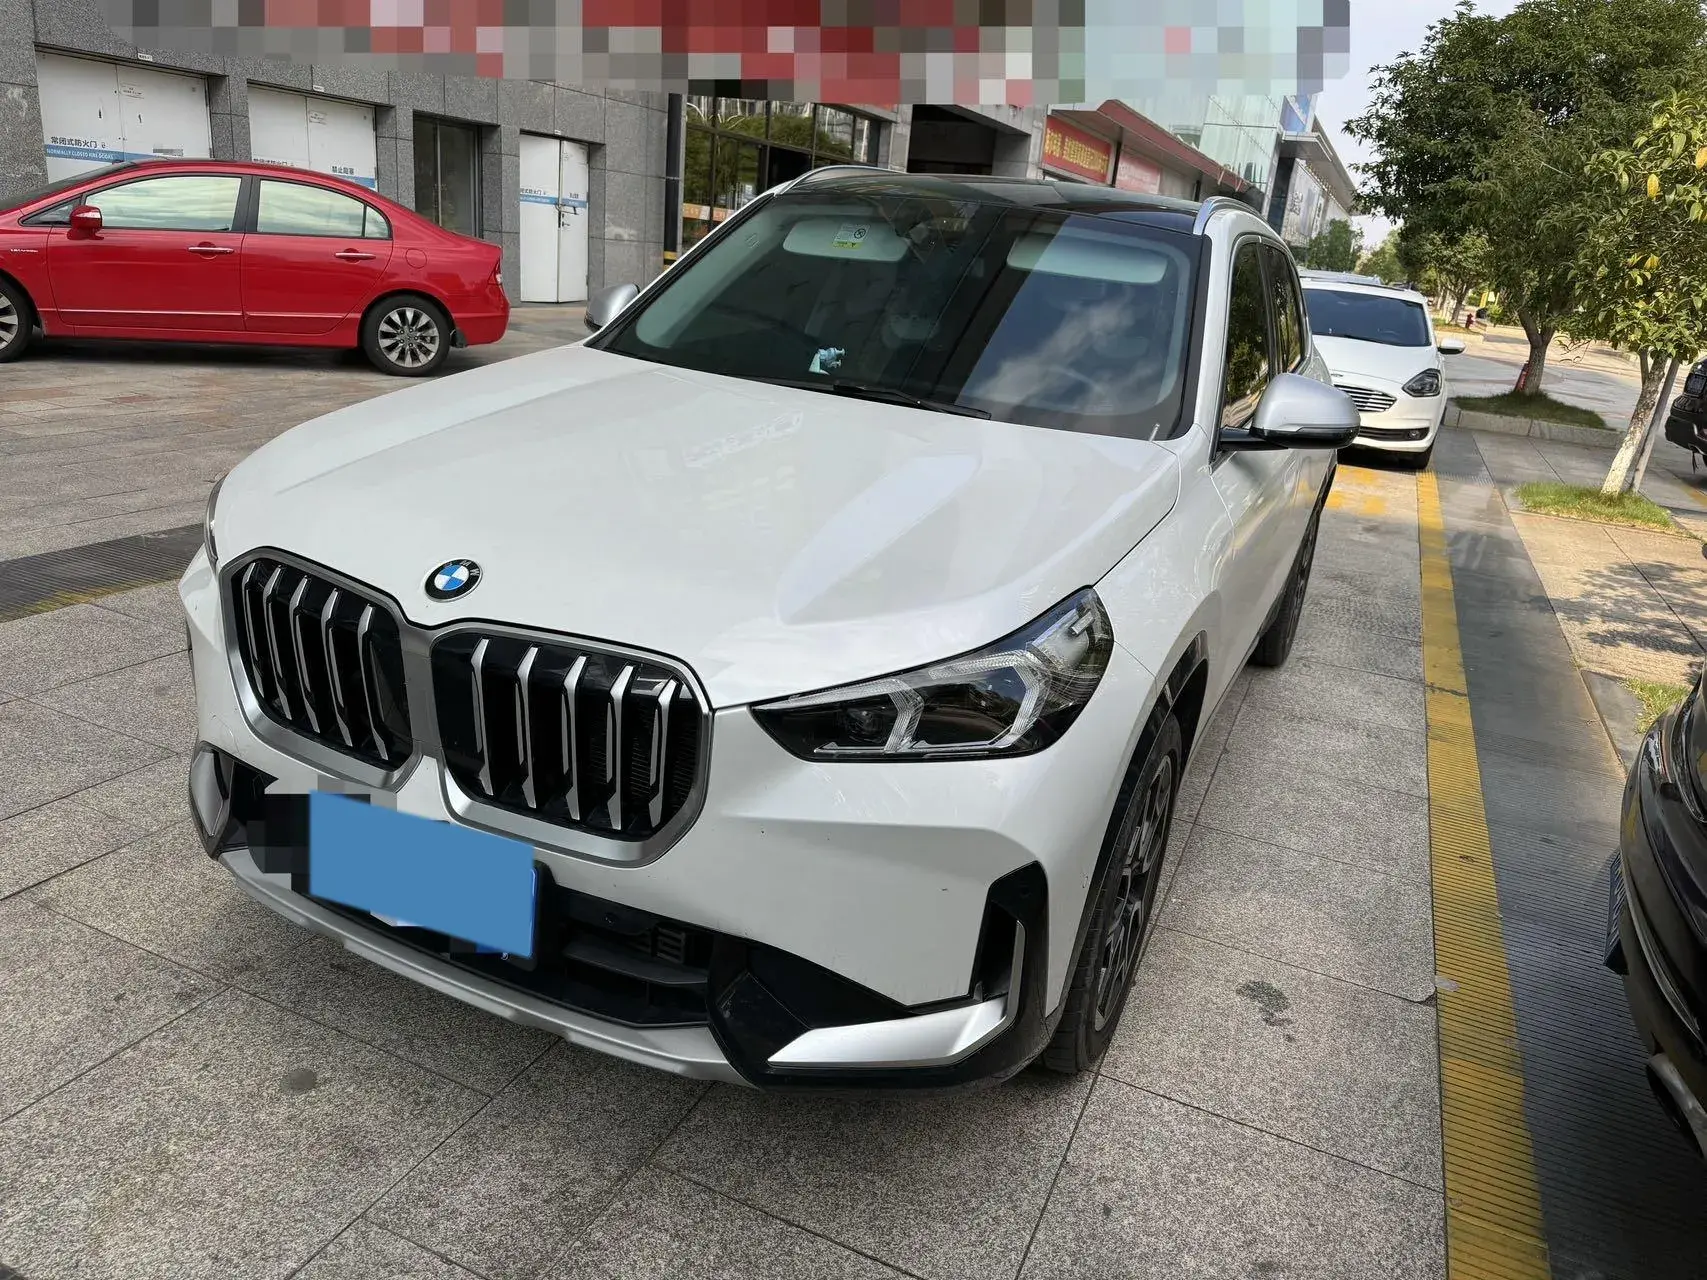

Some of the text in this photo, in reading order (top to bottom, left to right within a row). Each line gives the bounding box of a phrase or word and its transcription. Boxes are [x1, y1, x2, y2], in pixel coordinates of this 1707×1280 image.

[51, 136, 98, 148] 常闭式防火门
